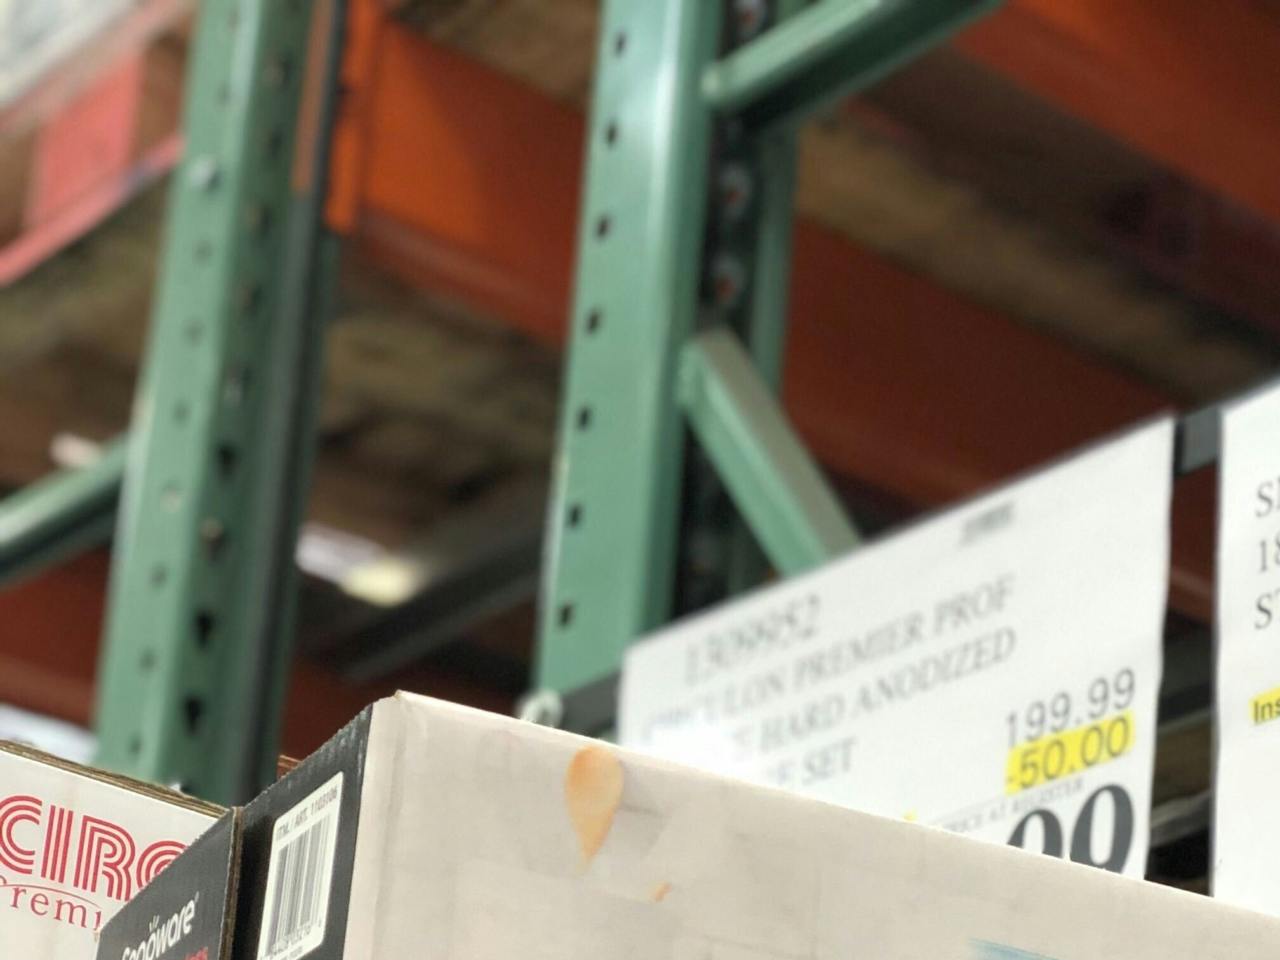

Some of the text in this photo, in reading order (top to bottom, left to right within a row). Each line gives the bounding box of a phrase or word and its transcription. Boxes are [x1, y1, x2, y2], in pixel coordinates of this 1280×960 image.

[854, 626, 1017, 711] ANODIZED
[1006, 667, 1136, 748] 199.99
[0, 875, 102, 931] remi
